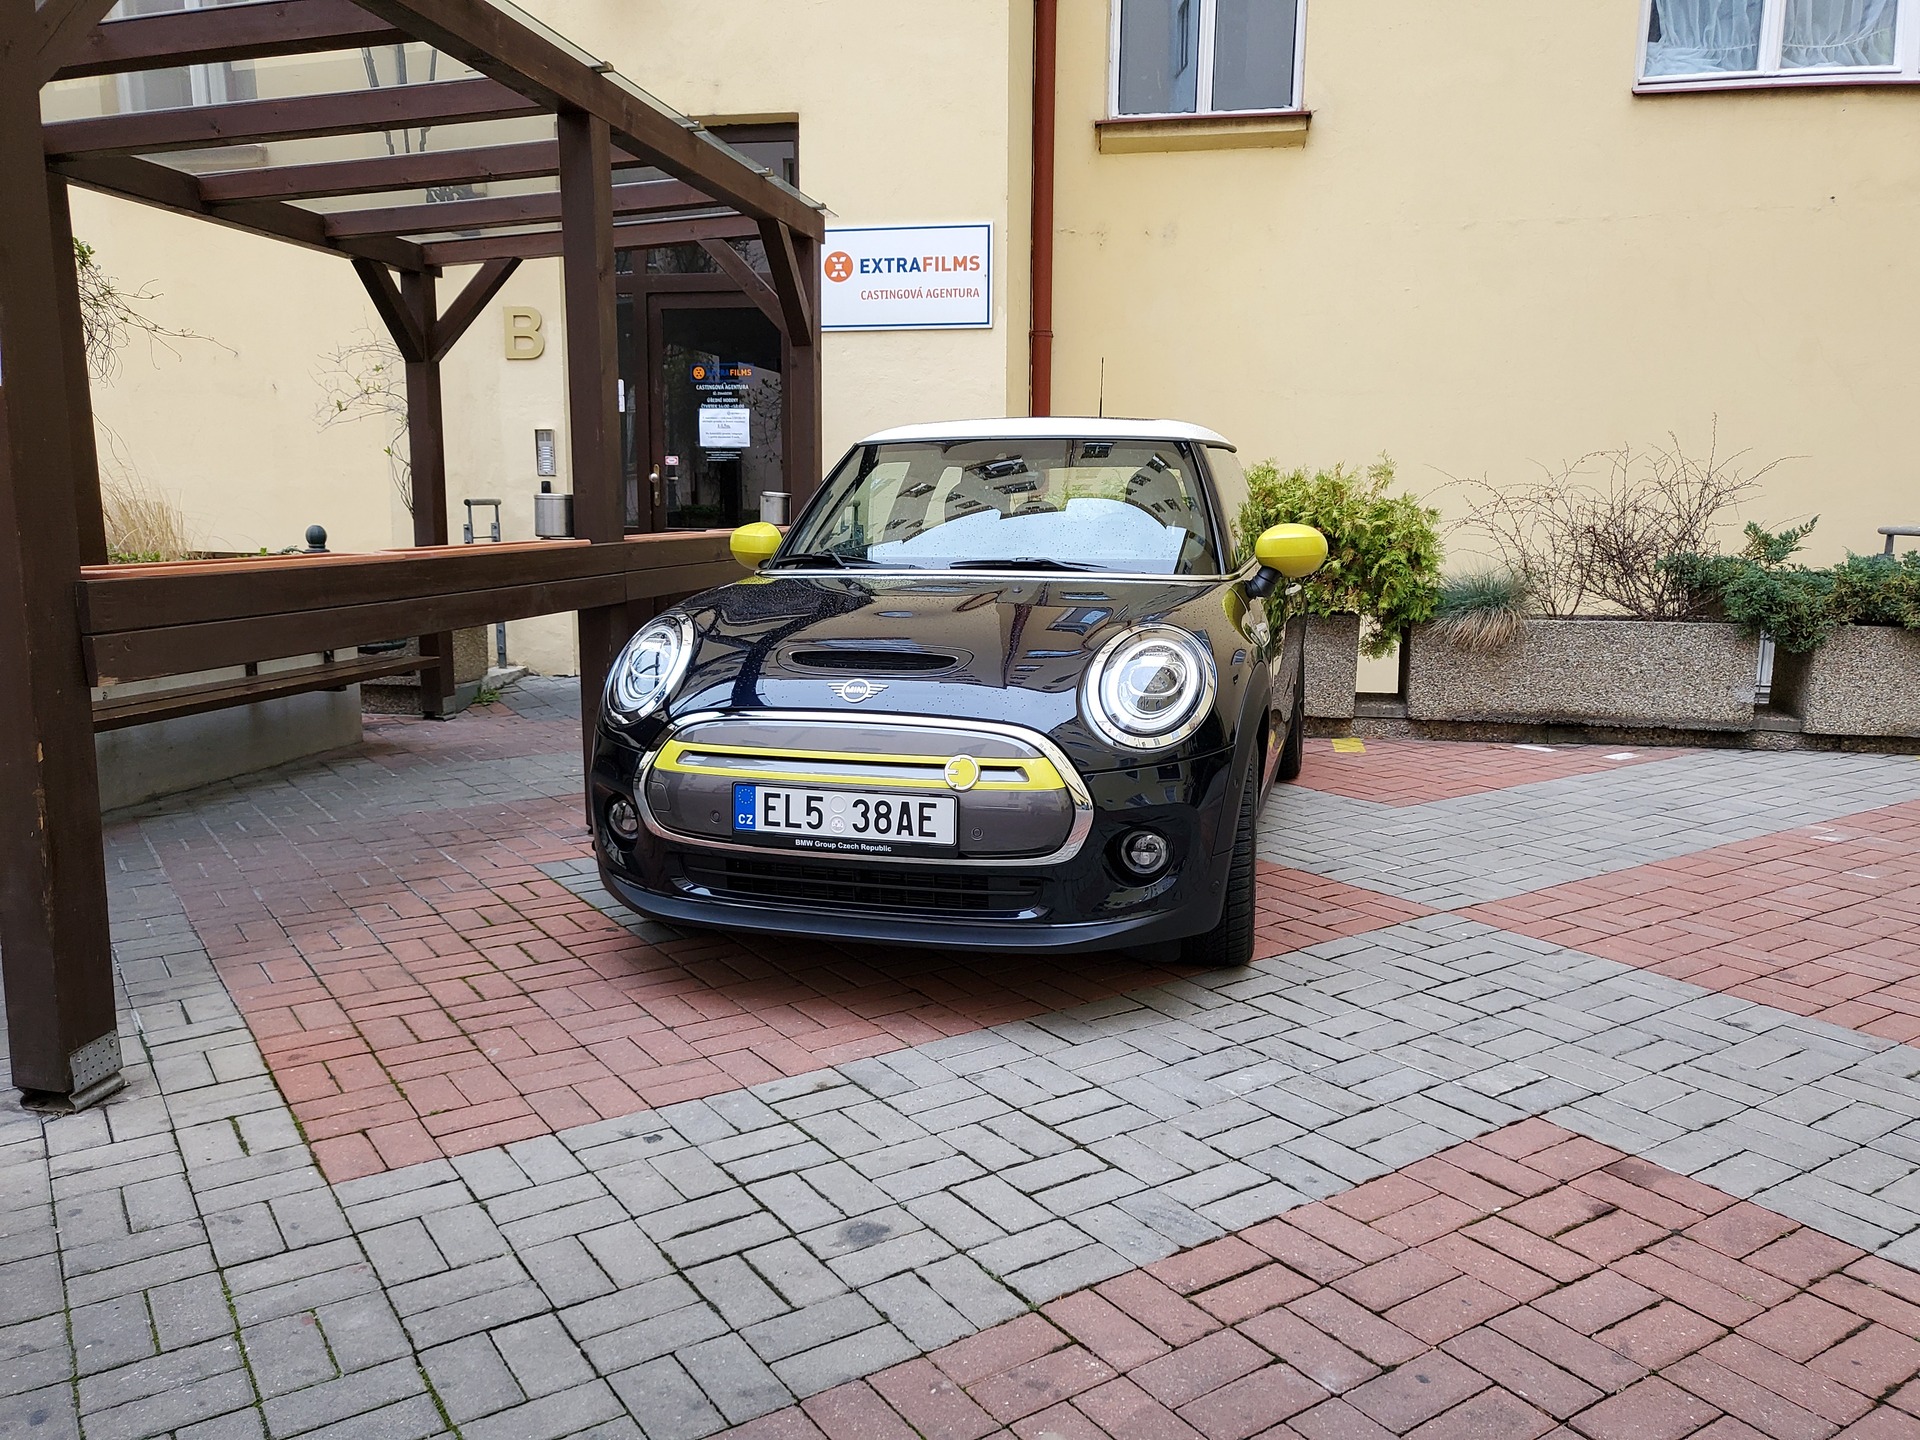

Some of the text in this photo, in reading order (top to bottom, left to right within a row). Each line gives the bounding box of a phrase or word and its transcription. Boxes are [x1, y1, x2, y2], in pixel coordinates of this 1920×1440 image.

[860, 255, 980, 274] EXTRAFILMS
[860, 287, 980, 300] CASTINGOVÁ AGENTURA
[503, 306, 545, 360] B
[845, 686, 867, 694] MINI
[738, 814, 753, 825] CZ
[763, 792, 938, 838] EL5 38AE
[795, 839, 892, 852] BMW Group Czech Republic
